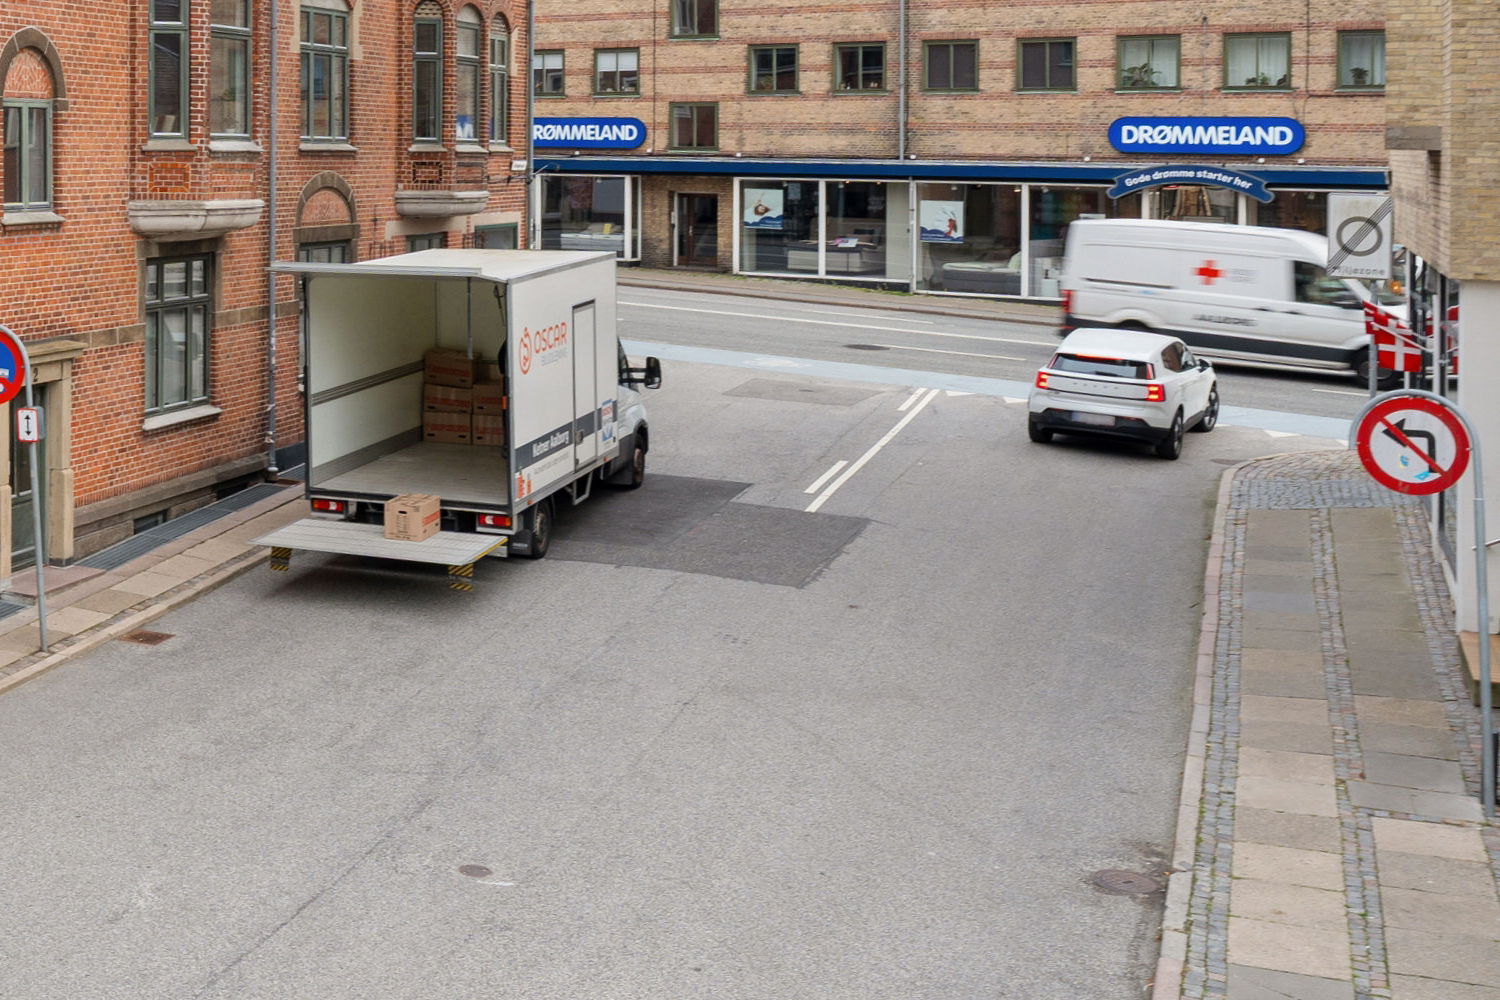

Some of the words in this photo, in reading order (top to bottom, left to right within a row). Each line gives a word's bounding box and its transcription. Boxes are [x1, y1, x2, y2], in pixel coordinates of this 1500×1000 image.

[533, 124, 638, 141] RØMMELAND
[1121, 125, 1294, 146] DRØMMELAND
[1124, 174, 1151, 187] Gode
[1152, 169, 1195, 180] drømme
[1196, 169, 1235, 184] starter
[1235, 176, 1254, 190] her
[534, 322, 567, 354] OSCAR
[33, 368, 38, 382] 2
